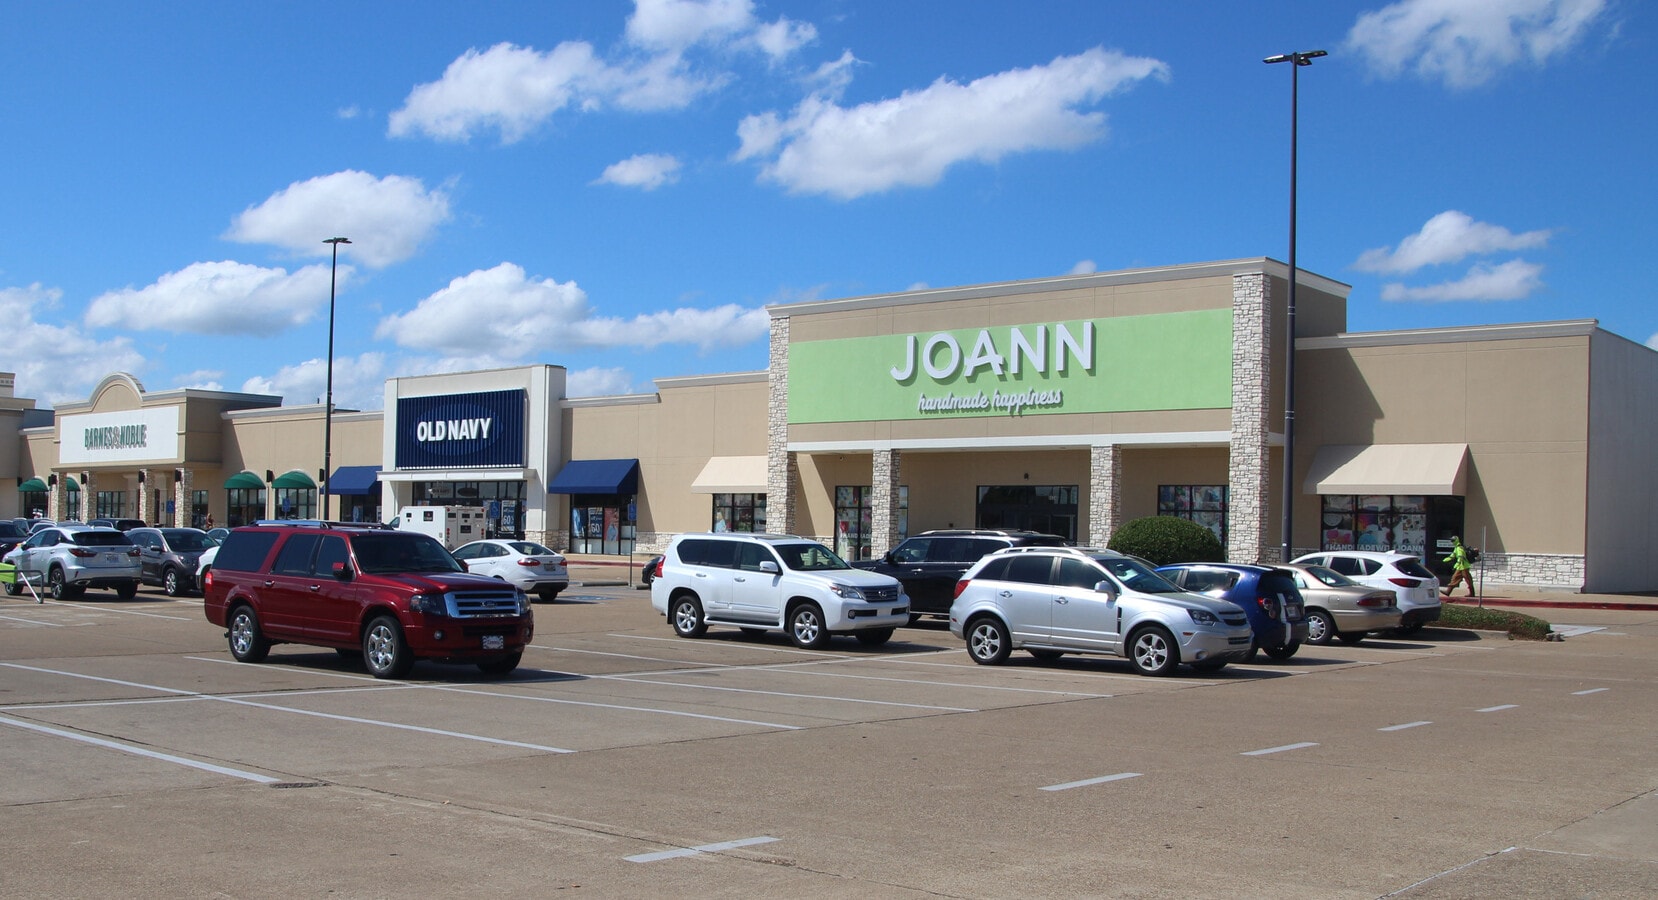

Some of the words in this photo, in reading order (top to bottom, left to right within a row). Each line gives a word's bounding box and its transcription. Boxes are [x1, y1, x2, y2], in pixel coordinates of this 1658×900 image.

[890, 321, 1095, 382] JOANN
[918, 391, 990, 414] handmade
[993, 388, 1063, 417] happiness
[85, 427, 112, 449] BARNES
[120, 424, 146, 447] NOBLE
[417, 420, 446, 442] OLD
[448, 417, 492, 441] NAVY
